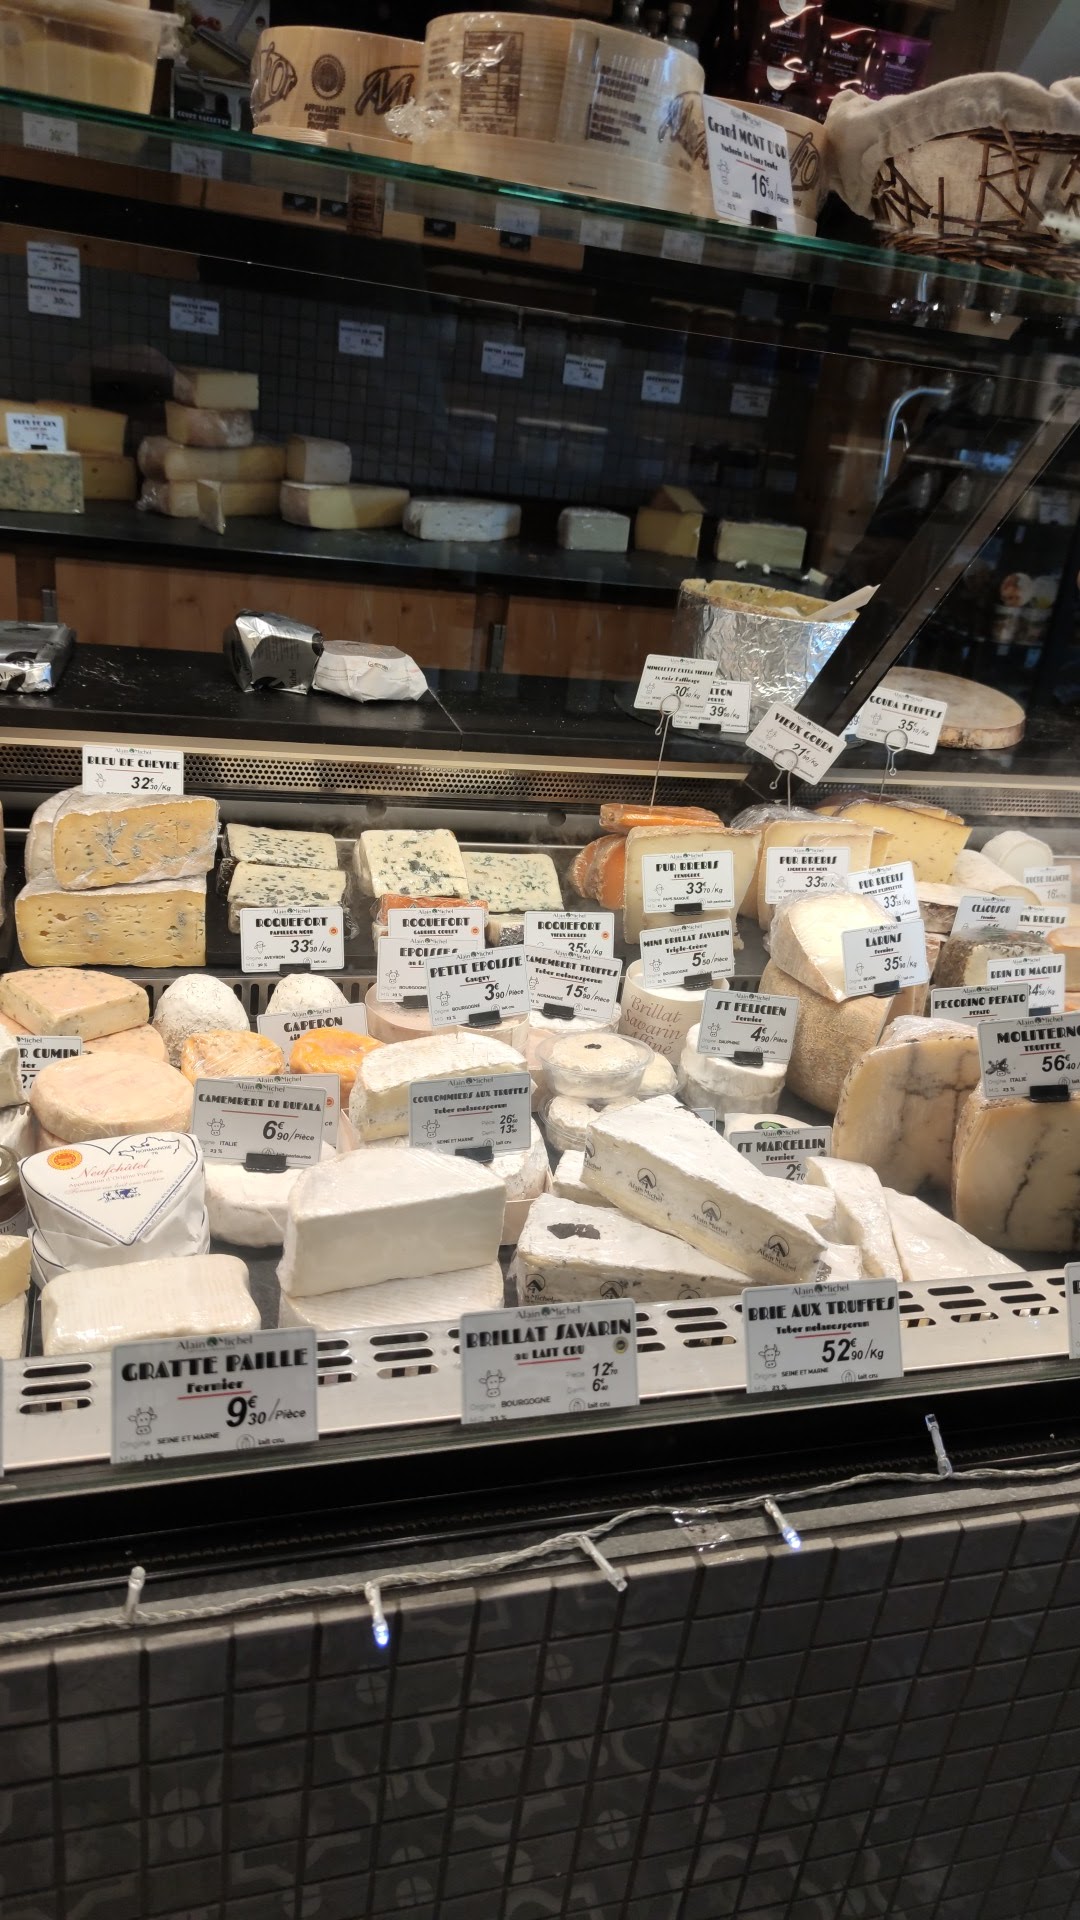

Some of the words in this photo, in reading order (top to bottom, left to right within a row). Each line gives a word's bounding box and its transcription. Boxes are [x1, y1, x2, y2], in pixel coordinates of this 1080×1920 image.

[707, 116, 737, 141] Grand
[739, 128, 765, 152] MONT
[646, 664, 677, 674] MIMOLETTE
[868, 695, 899, 709] GOUDA
[901, 703, 942, 719] TRUFFES
[773, 712, 804, 735] VIEUX
[803, 730, 834, 754] GOUDA
[87, 755, 111, 767] BLEU
[119, 758, 133, 768] DE
[655, 863, 676, 872] PUR
[679, 860, 719, 871] BREBIS
[779, 856, 799, 866] PUR
[801, 856, 838, 865] BREBIS
[858, 879, 875, 890] PUR
[876, 872, 904, 886] BREBIS
[255, 917, 329, 928] ROQUEFORT
[402, 917, 470, 928] ROQUEFORT
[537, 921, 602, 931] ROQUEFORT
[1033, 915, 1067, 925] BREBIS
[643, 940, 663, 948] MINI
[664, 934, 697, 946] BRILLAT
[698, 929, 730, 940] SAVARIN
[865, 932, 903, 948] LARUNS
[399, 947, 459, 957] EPOISSES
[430, 963, 469, 978] PETIT
[471, 955, 524, 973] EPOISSE
[525, 954, 578, 971] CAMEMBERT
[580, 964, 619, 978] TRUFFES
[535, 967, 556, 977] Tuber
[990, 968, 1012, 980] BRIN
[1014, 967, 1027, 977] DU
[1028, 964, 1064, 976] MAQUIS
[631, 994, 683, 1024] Brillat
[715, 1000, 732, 1011] ST
[734, 1002, 788, 1017] FELICIEN
[934, 996, 986, 1010] PECORINO
[988, 993, 1027, 1006] PEPATO
[735, 1014, 763, 1024] Fermier
[968, 1009, 991, 1017] PEPATO
[283, 1016, 343, 1033] GAPERON
[624, 1008, 686, 1040] Savarin
[33, 1048, 79, 1059] CUMIN
[1023, 1041, 1062, 1052] TRUFFEE
[235, 1082, 255, 1090] Alain
[261, 1084, 286, 1093] Michel
[256, 1076, 274, 1084] Alain
[472, 1076, 494, 1085] Michel
[1009, 1076, 1027, 1084] ITALIE
[198, 1093, 265, 1107] CAMEMBERT
[266, 1099, 281, 1109] DI
[282, 1101, 322, 1112] BUFALA
[412, 1091, 475, 1104] COULOMMIERS
[475, 1089, 491, 1098] AUX
[492, 1087, 529, 1096] TRUFFES
[433, 1106, 455, 1115] Tuber
[135, 1144, 172, 1154] NORMANDIE
[737, 1142, 753, 1154] ST
[756, 1138, 827, 1153] MARCELLIN
[765, 1153, 796, 1162] Fermier
[72, 1159, 151, 1180] Neufchâtel
[792, 1286, 815, 1296] Alain
[823, 1284, 849, 1293] Michel
[517, 1310, 541, 1320] Alain
[550, 1305, 581, 1316] Michel
[747, 1305, 788, 1321] BRIE
[791, 1302, 823, 1319] AUX
[825, 1296, 896, 1315] TRUFFES
[466, 1325, 549, 1349] BRILLAT
[554, 1318, 632, 1341] SAVARIN
[776, 1325, 804, 1335] Tuber
[805, 1320, 870, 1333] melanosporum
[177, 1340, 206, 1351] Alain
[217, 1334, 253, 1346] Michel
[532, 1347, 560, 1359] LAIT
[562, 1344, 585, 1357] CRU
[121, 1356, 219, 1382] GRATTE
[225, 1347, 309, 1374] PAILLE
[780, 1370, 799, 1378] SEINE
[799, 1369, 808, 1377] ET
[808, 1367, 830, 1376] MARNE
[186, 1377, 244, 1394] Fermier
[501, 1396, 551, 1408] BOURGOGNE
[157, 1436, 179, 1445] SEINE
[180, 1434, 192, 1443] ET
[192, 1432, 221, 1442] MARNE
